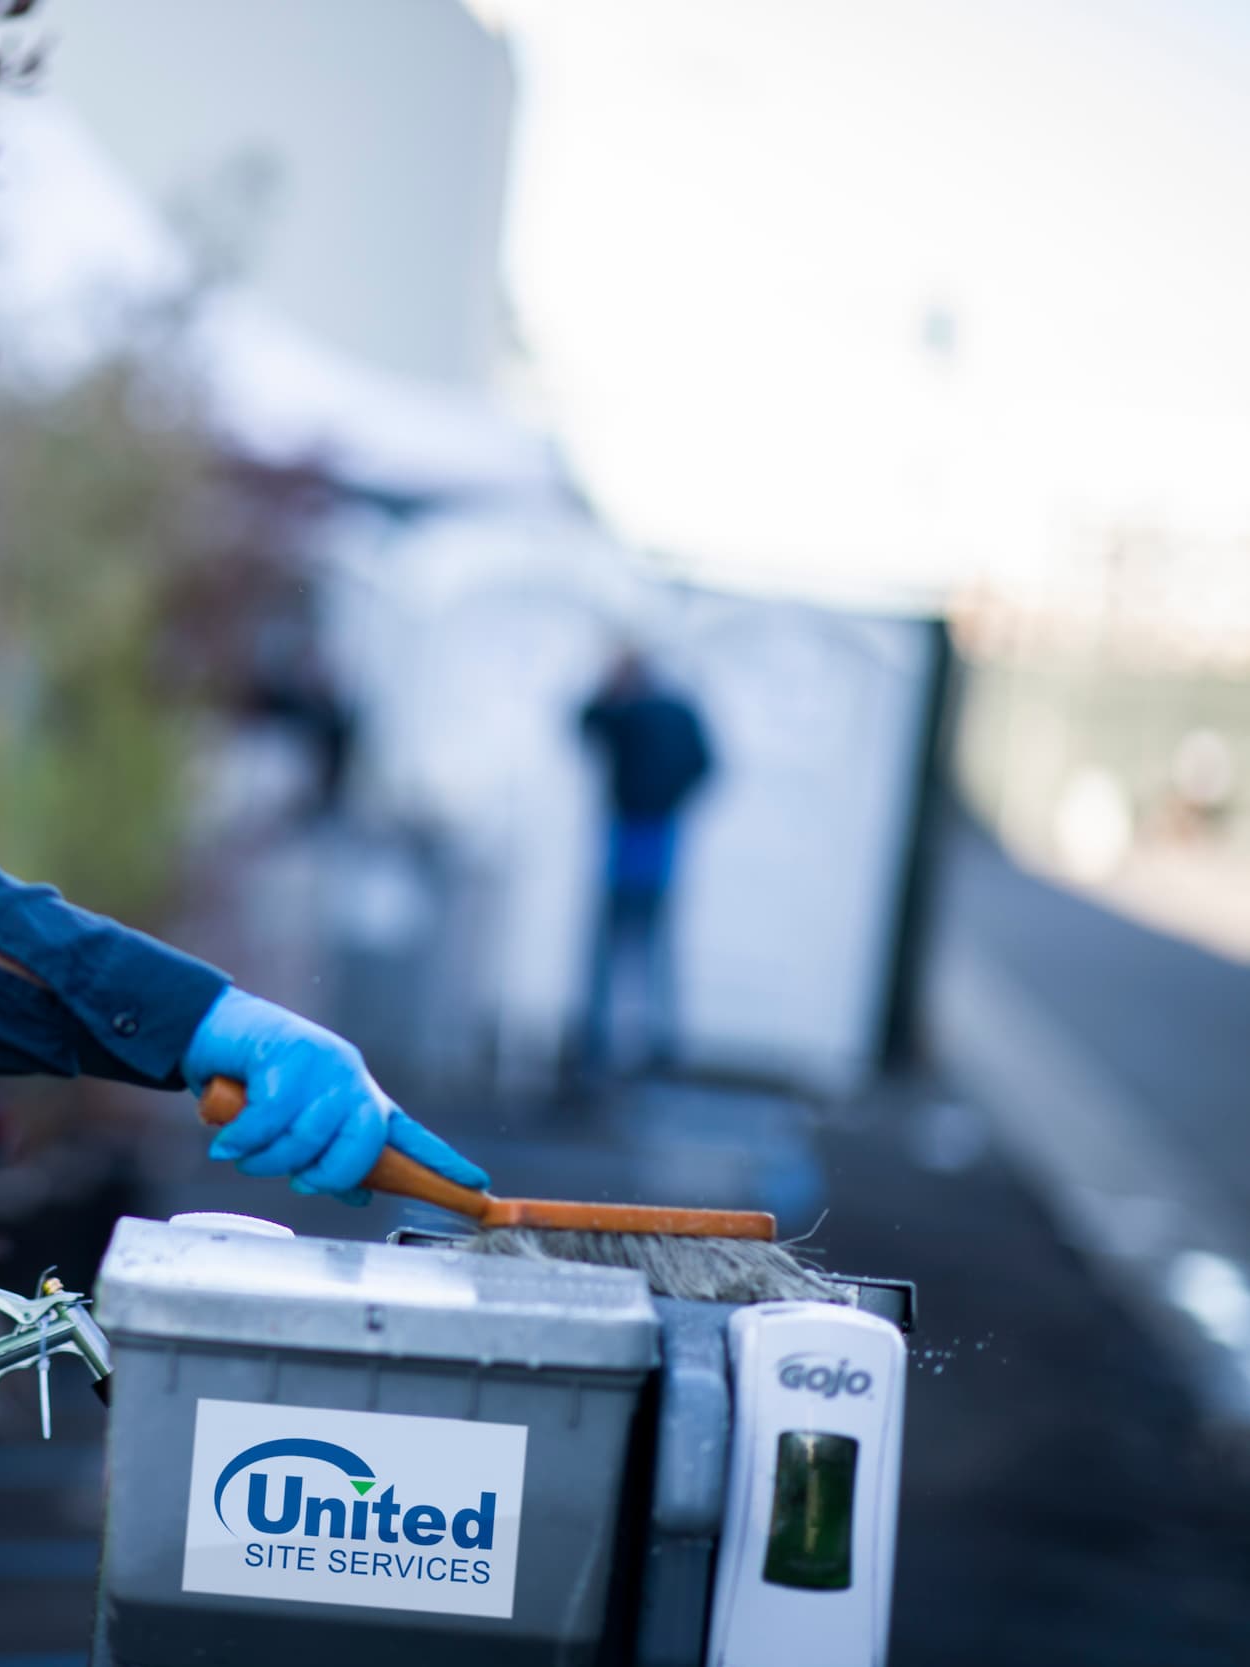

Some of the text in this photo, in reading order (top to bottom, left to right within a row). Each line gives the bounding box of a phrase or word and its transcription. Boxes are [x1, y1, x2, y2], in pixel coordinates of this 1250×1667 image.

[247, 1472, 497, 1550] United
[244, 1543, 491, 1584] SITE SERVICES
